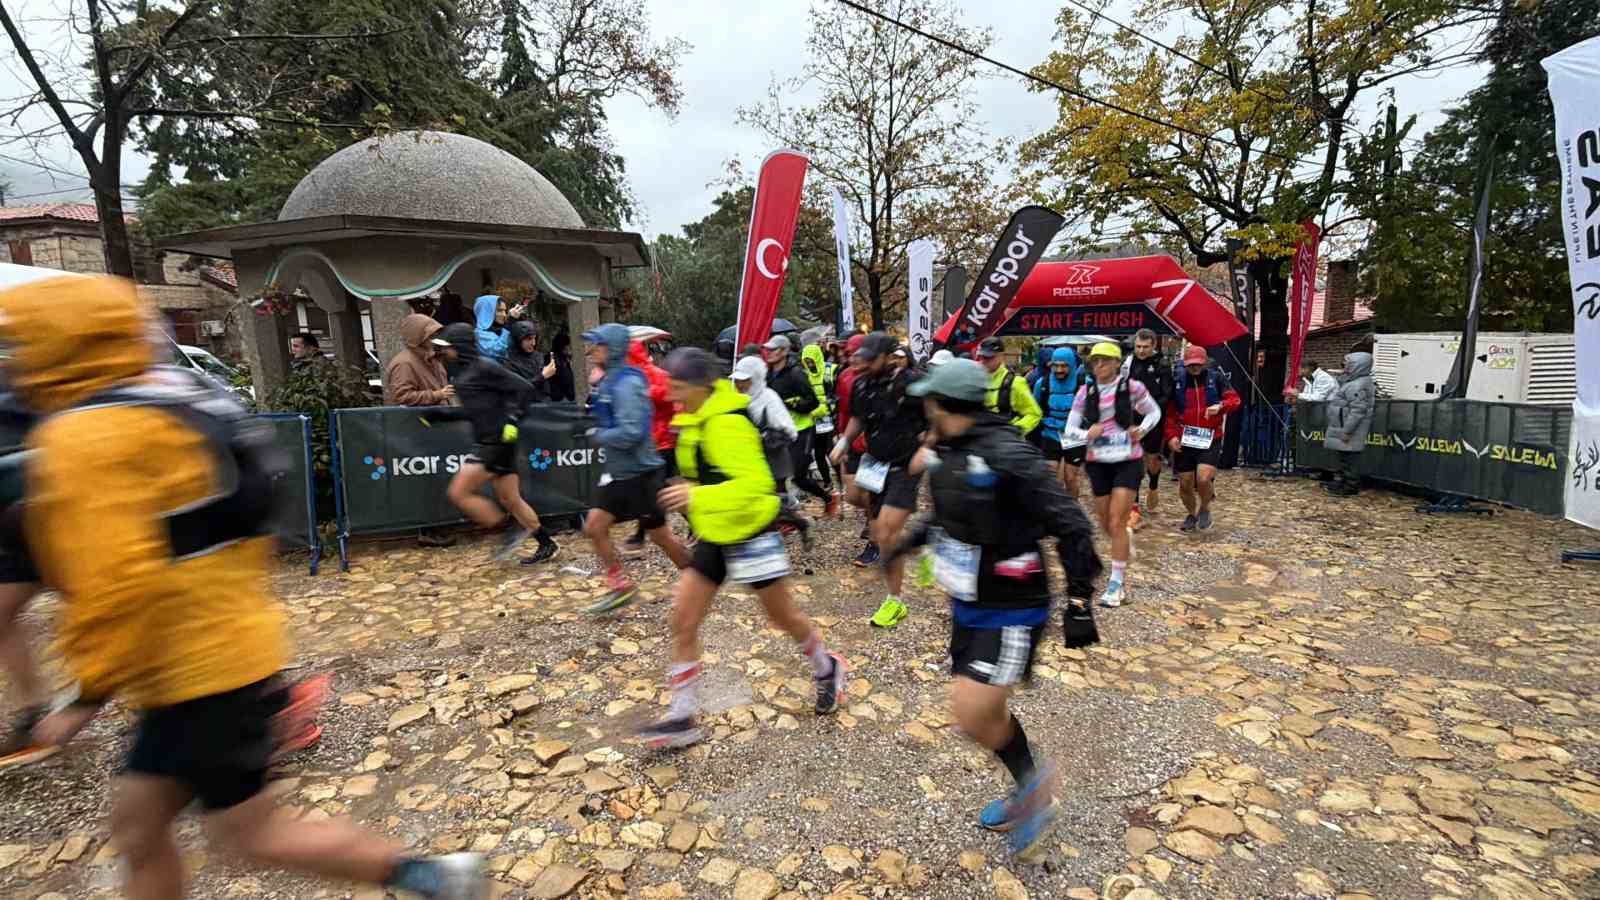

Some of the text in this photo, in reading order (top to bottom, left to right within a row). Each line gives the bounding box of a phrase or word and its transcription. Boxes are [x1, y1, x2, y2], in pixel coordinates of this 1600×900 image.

[967, 228, 1034, 326] kar spor
[1053, 285, 1110, 297] ROSSIST
[1021, 311, 1145, 330] START-FINISH
[1415, 437, 1463, 455] SALEWA
[392, 456, 440, 476] kar
[556, 448, 594, 466] kar
[1489, 444, 1558, 470] SALEWA
